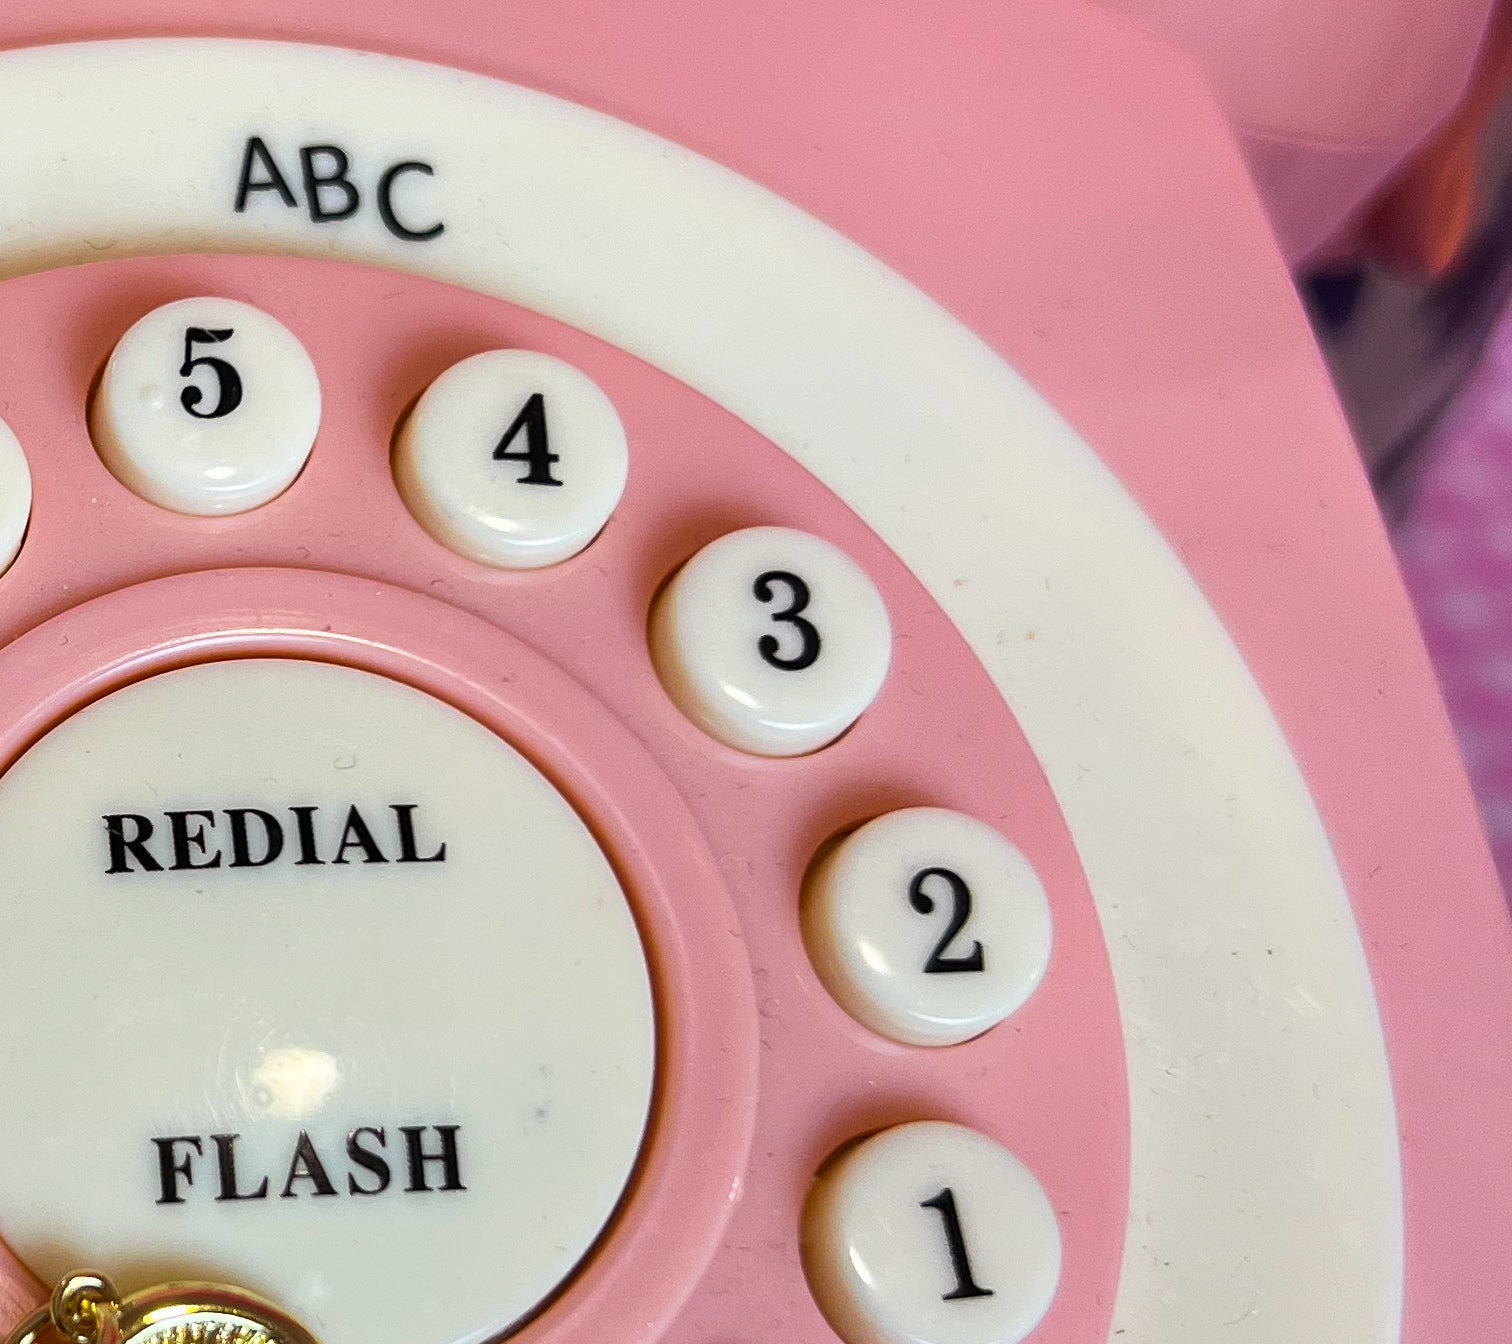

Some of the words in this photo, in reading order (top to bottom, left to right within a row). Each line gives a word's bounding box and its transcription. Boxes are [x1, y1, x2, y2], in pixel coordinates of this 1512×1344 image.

[235, 136, 444, 242] ABC
[180, 327, 242, 419] 5
[493, 393, 563, 486] 4
[753, 571, 822, 671] 3
[102, 805, 446, 874] REDIAL
[908, 867, 985, 974] 2
[151, 1125, 466, 1205] FLASH
[920, 1188, 994, 1300] 1
